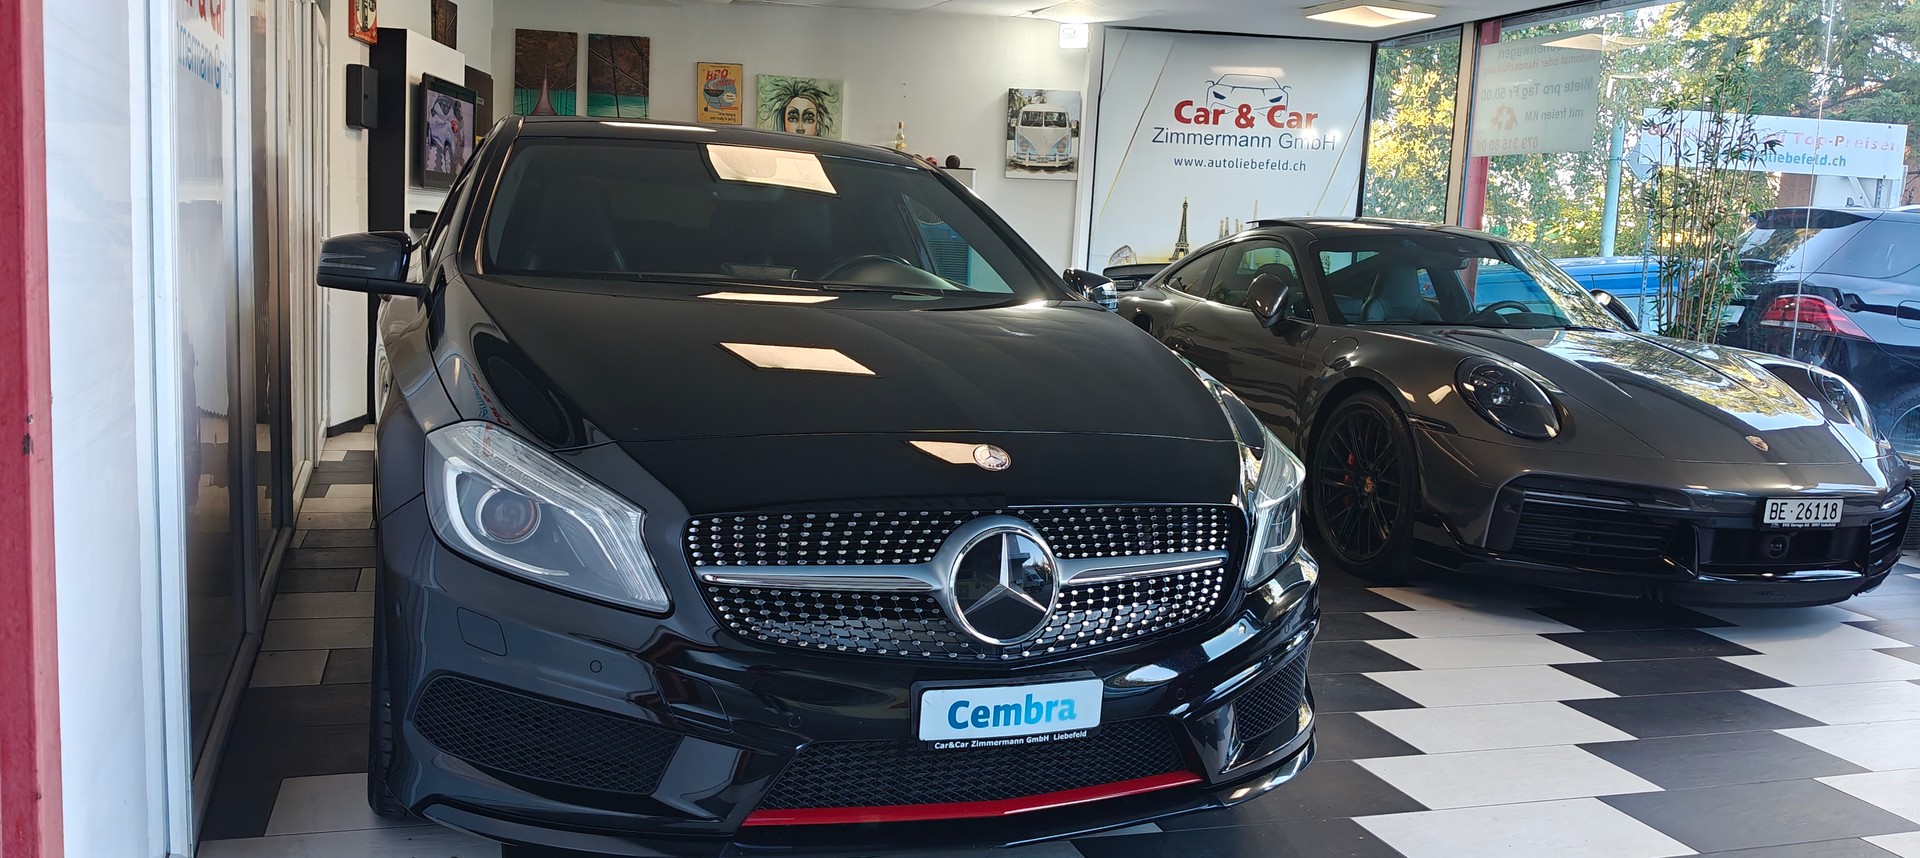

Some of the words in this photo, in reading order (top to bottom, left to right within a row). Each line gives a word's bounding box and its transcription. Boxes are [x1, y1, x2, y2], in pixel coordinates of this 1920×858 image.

[1174, 100, 1226, 126] Car
[1234, 103, 1256, 130] &
[1266, 104, 1319, 131] Car
[1151, 126, 1272, 149] Zimmermann
[1278, 132, 1336, 151] GmbH
[1174, 157, 1307, 172] www.autoliebefeld.ch
[947, 693, 1077, 730] Cembra
[934, 741, 969, 750] Car&Car
[970, 737, 1025, 748] Zimmermann
[1026, 735, 1050, 744] GmbH
[1053, 730, 1088, 741] Liebefeld
